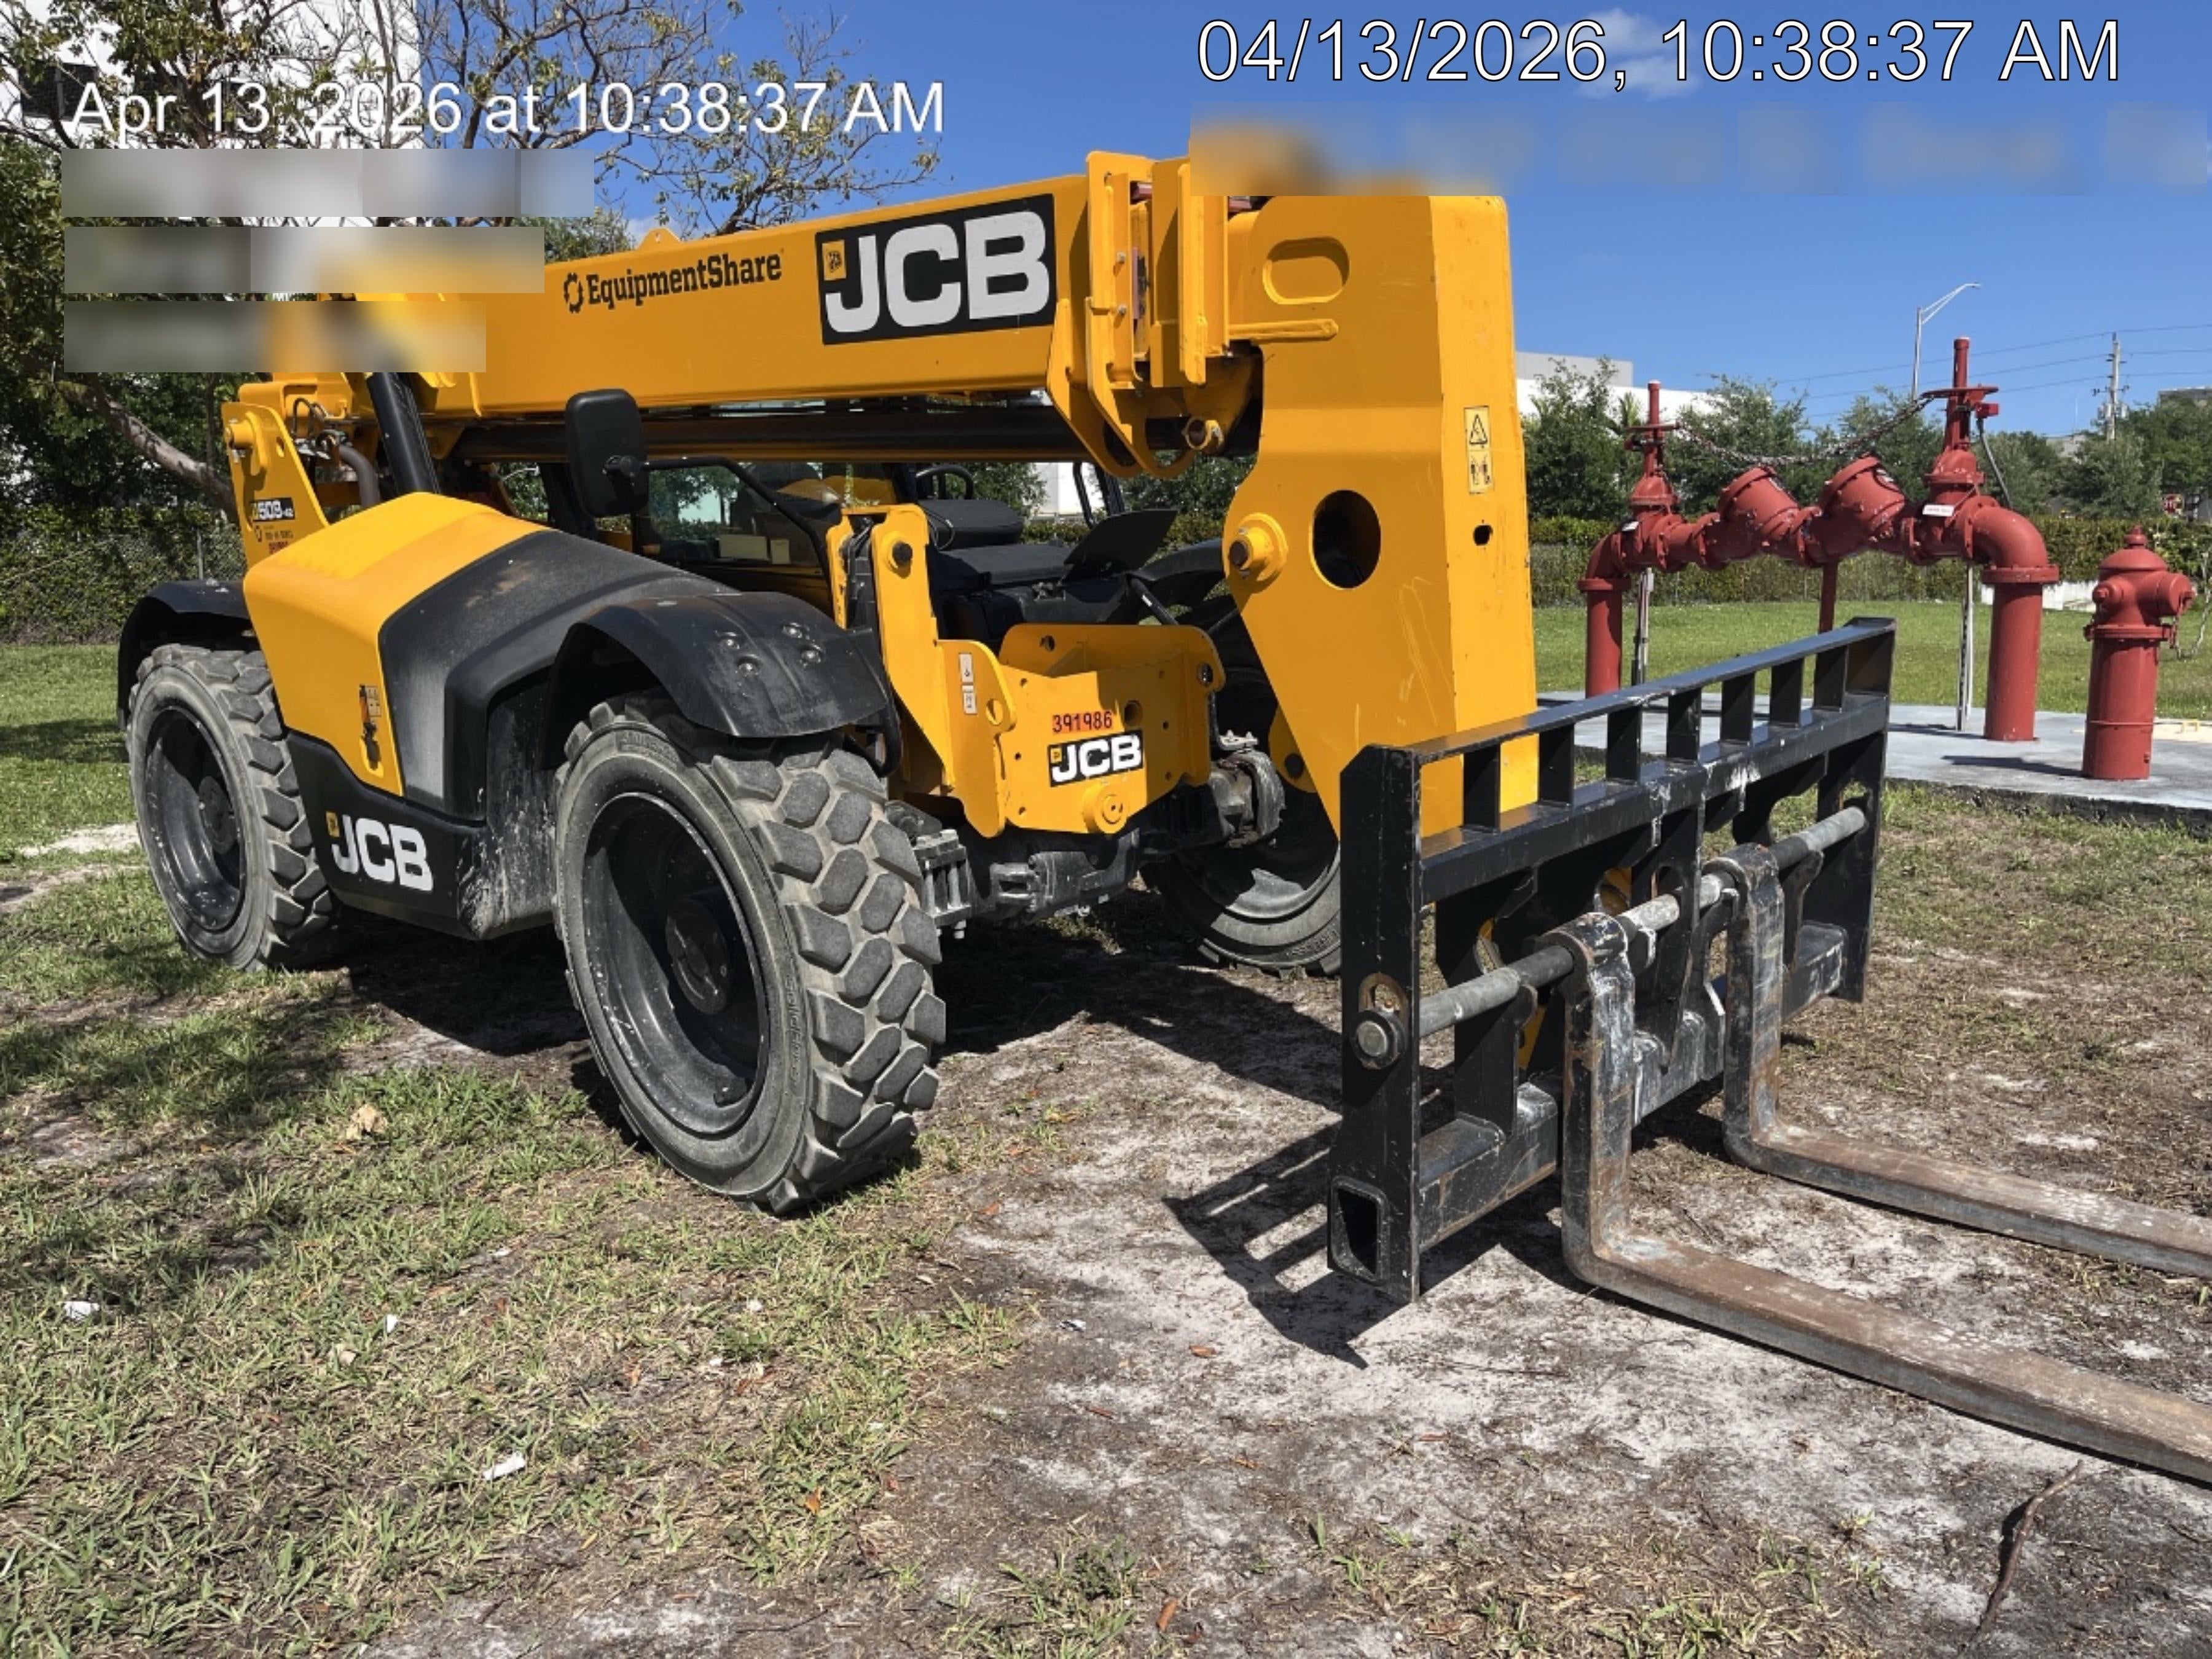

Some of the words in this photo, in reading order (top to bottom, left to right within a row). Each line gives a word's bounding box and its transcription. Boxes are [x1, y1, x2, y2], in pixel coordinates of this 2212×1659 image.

[586, 253, 782, 307] EquipmentShare
[824, 210, 1050, 333] JCB
[1052, 711, 1113, 733] 391986
[1051, 734, 1143, 783] JCB
[331, 814, 434, 892] JCB
